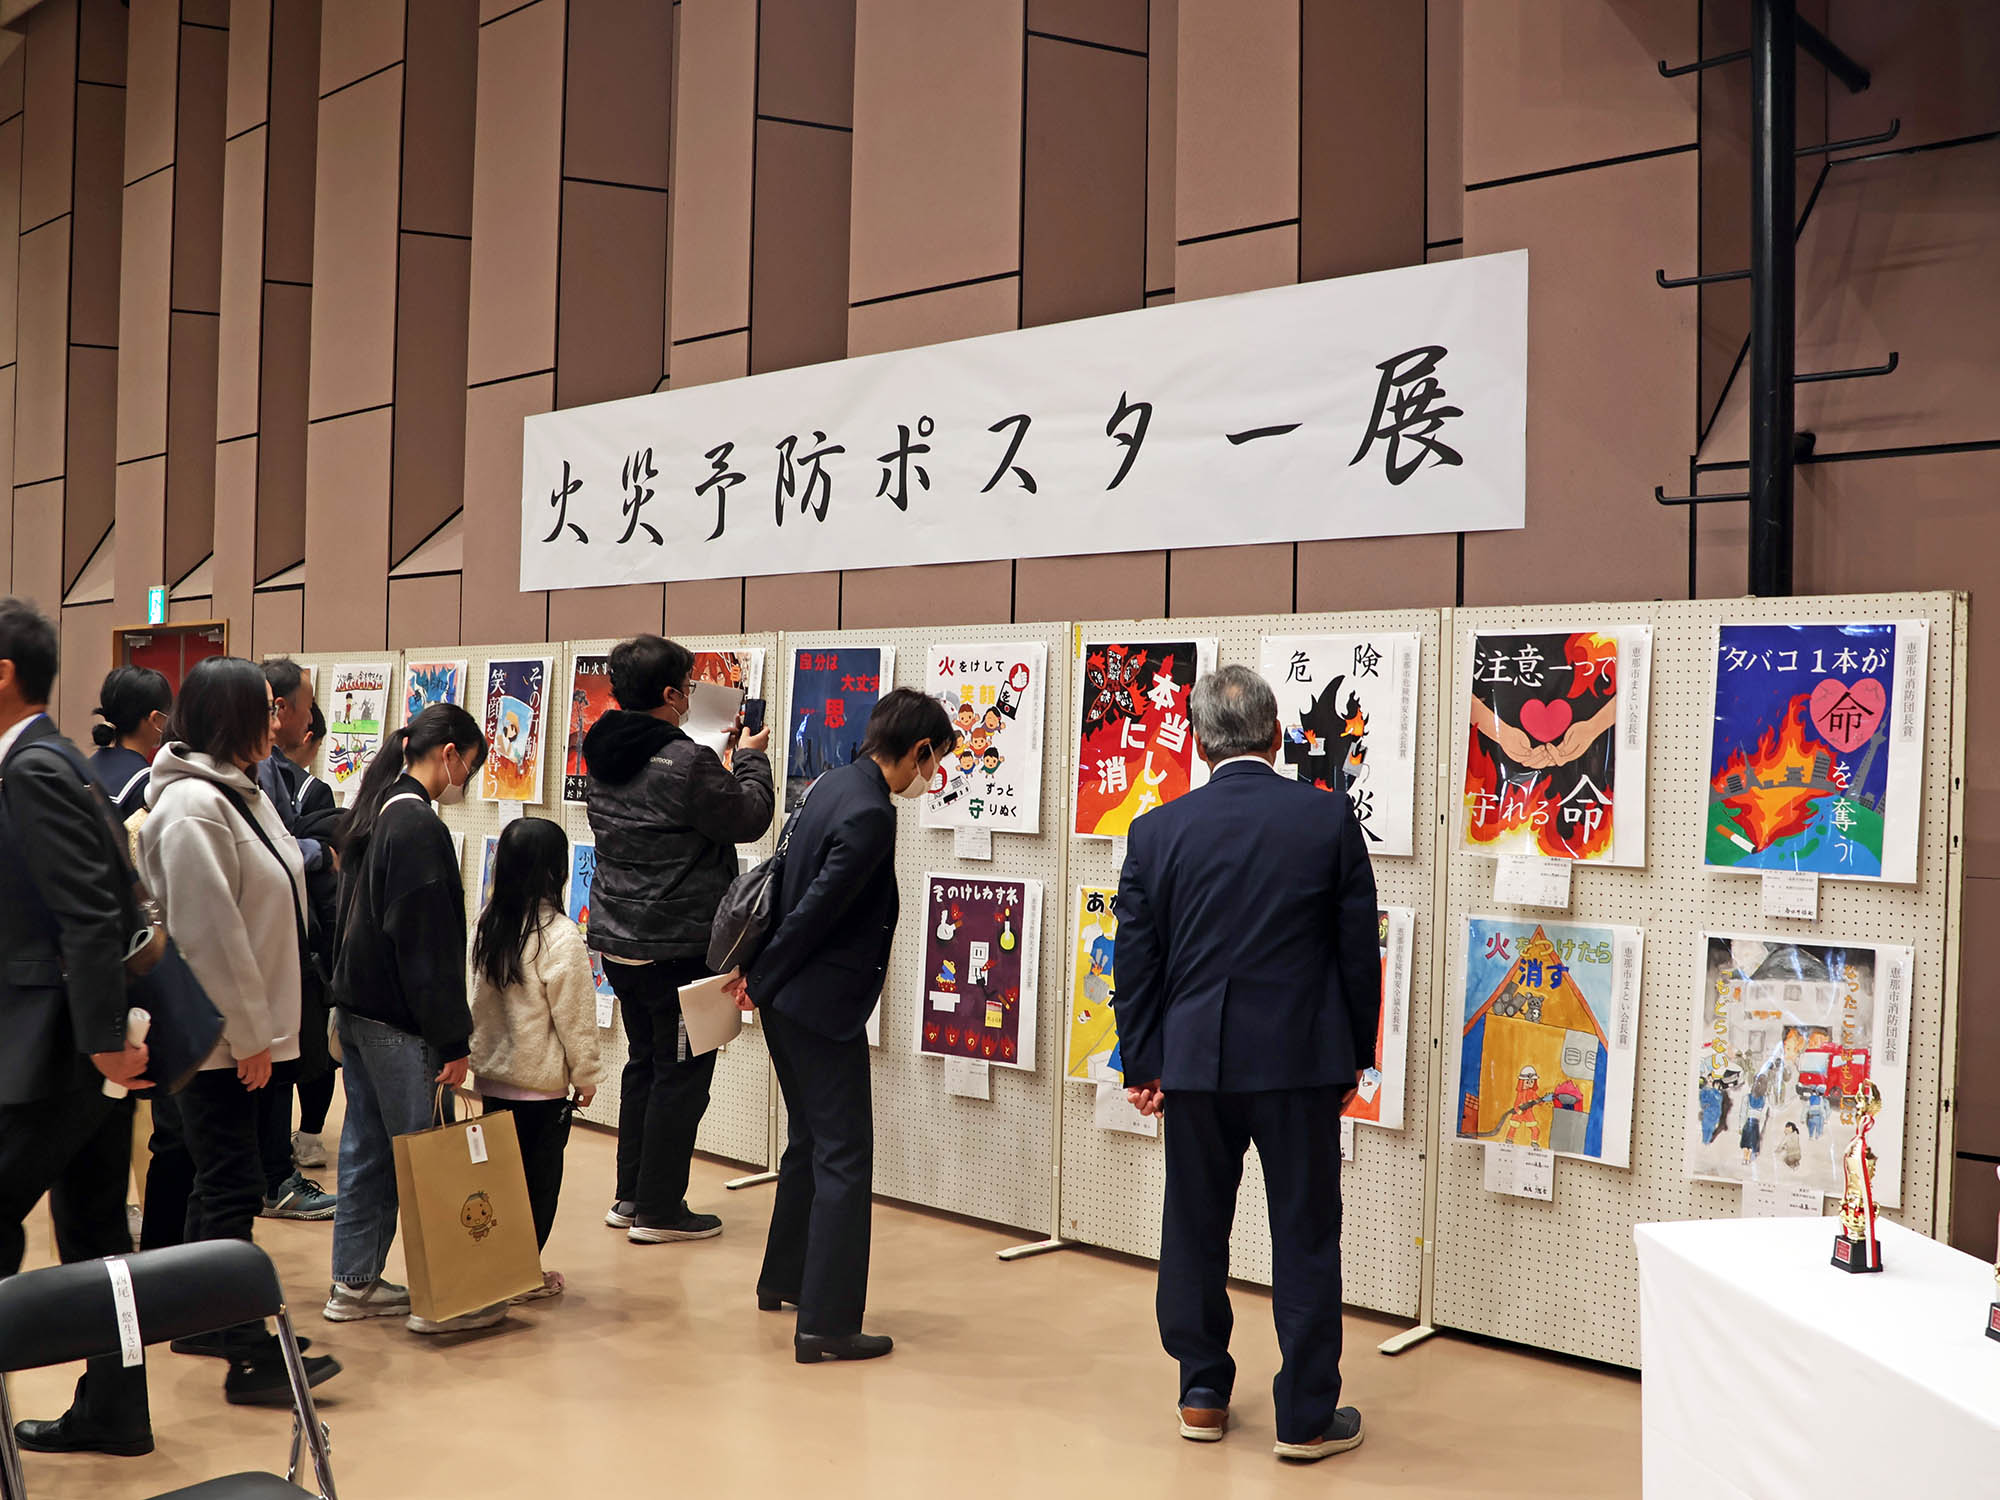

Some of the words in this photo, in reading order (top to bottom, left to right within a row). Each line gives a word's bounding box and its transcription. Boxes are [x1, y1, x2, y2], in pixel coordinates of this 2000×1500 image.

[541, 344, 1464, 546] 火災予防ポスター展
[799, 654, 838, 672] 自分は
[938, 656, 1005, 677] 火をけして
[959, 683, 997, 705] 笑顔
[1902, 642, 1917, 738] 恵那市消防団長賞
[1818, 690, 1875, 744] 命
[968, 798, 1018, 820] 守りぬく
[986, 782, 1014, 798] ずっと
[1465, 773, 1614, 844] 守れる命
[1831, 760, 1857, 864] を奪う
[1484, 932, 1613, 963] 火をつけたら
[1517, 958, 1570, 989] 消す
[1618, 946, 1637, 1046] 恵那市まとい会長賞
[1885, 967, 1901, 1062] 恵那市消防団長賞
